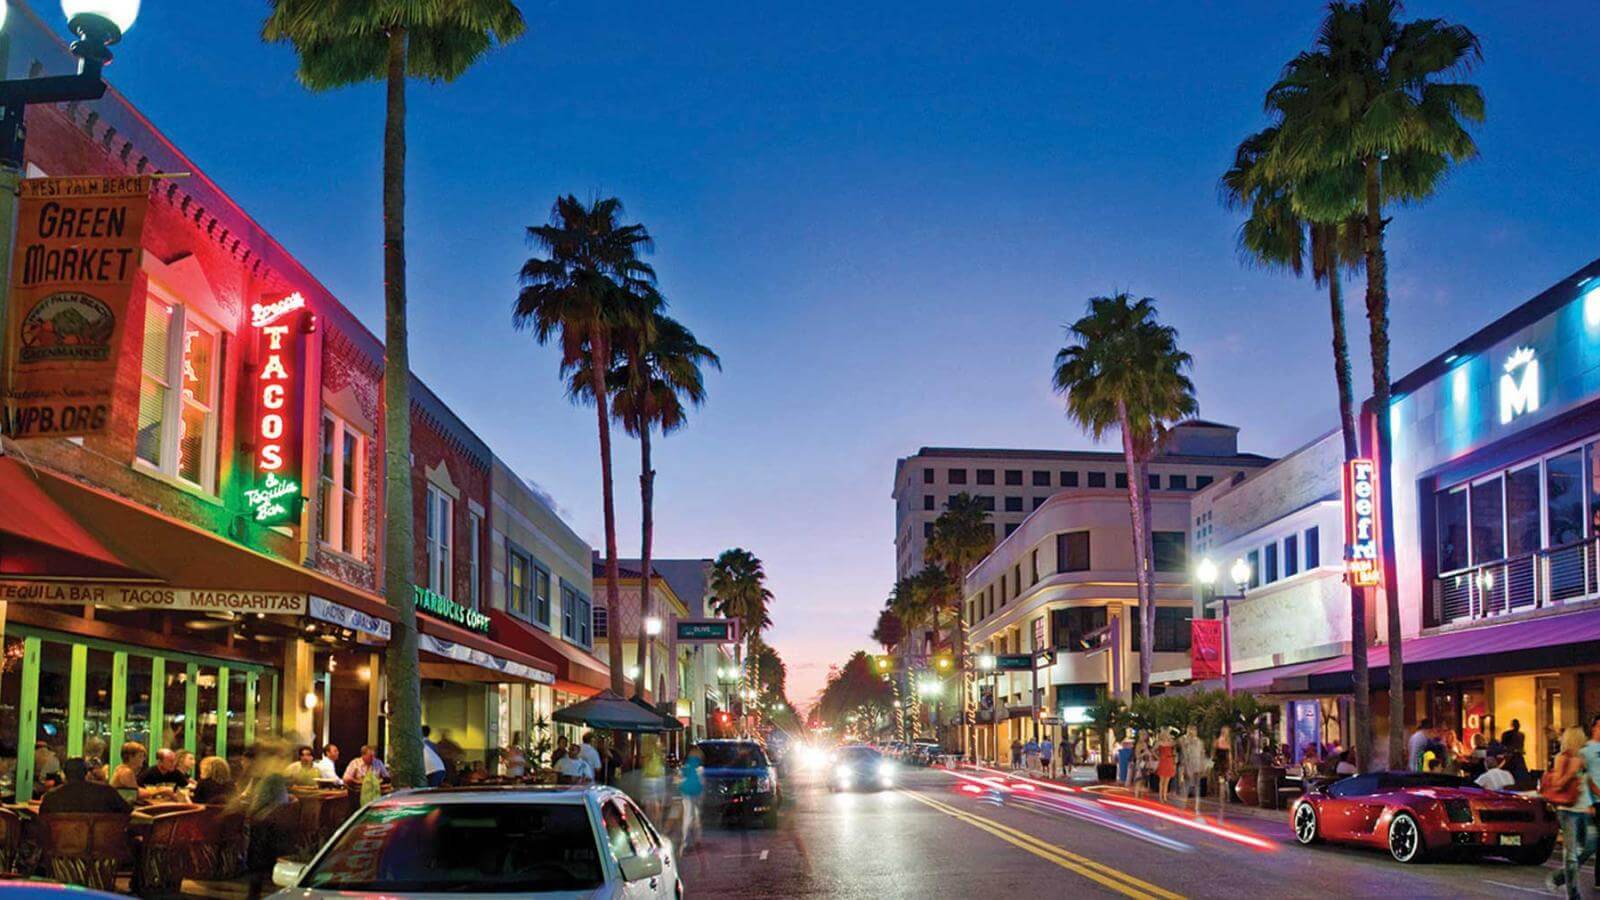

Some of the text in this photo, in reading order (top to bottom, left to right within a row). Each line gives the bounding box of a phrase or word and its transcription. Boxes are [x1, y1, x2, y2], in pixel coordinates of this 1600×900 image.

[29, 175, 142, 196] WEST PALM BEACH
[38, 202, 127, 238] GREEN
[23, 243, 133, 284] MARKET
[260, 325, 289, 470] TACOS
[243, 480, 299, 506] Tequila
[265, 472, 279, 488] &
[255, 503, 286, 521] Bar
[1355, 463, 1373, 540] reef
[0, 584, 301, 611] TEQUILA BAR TACOS MARGARITAS
